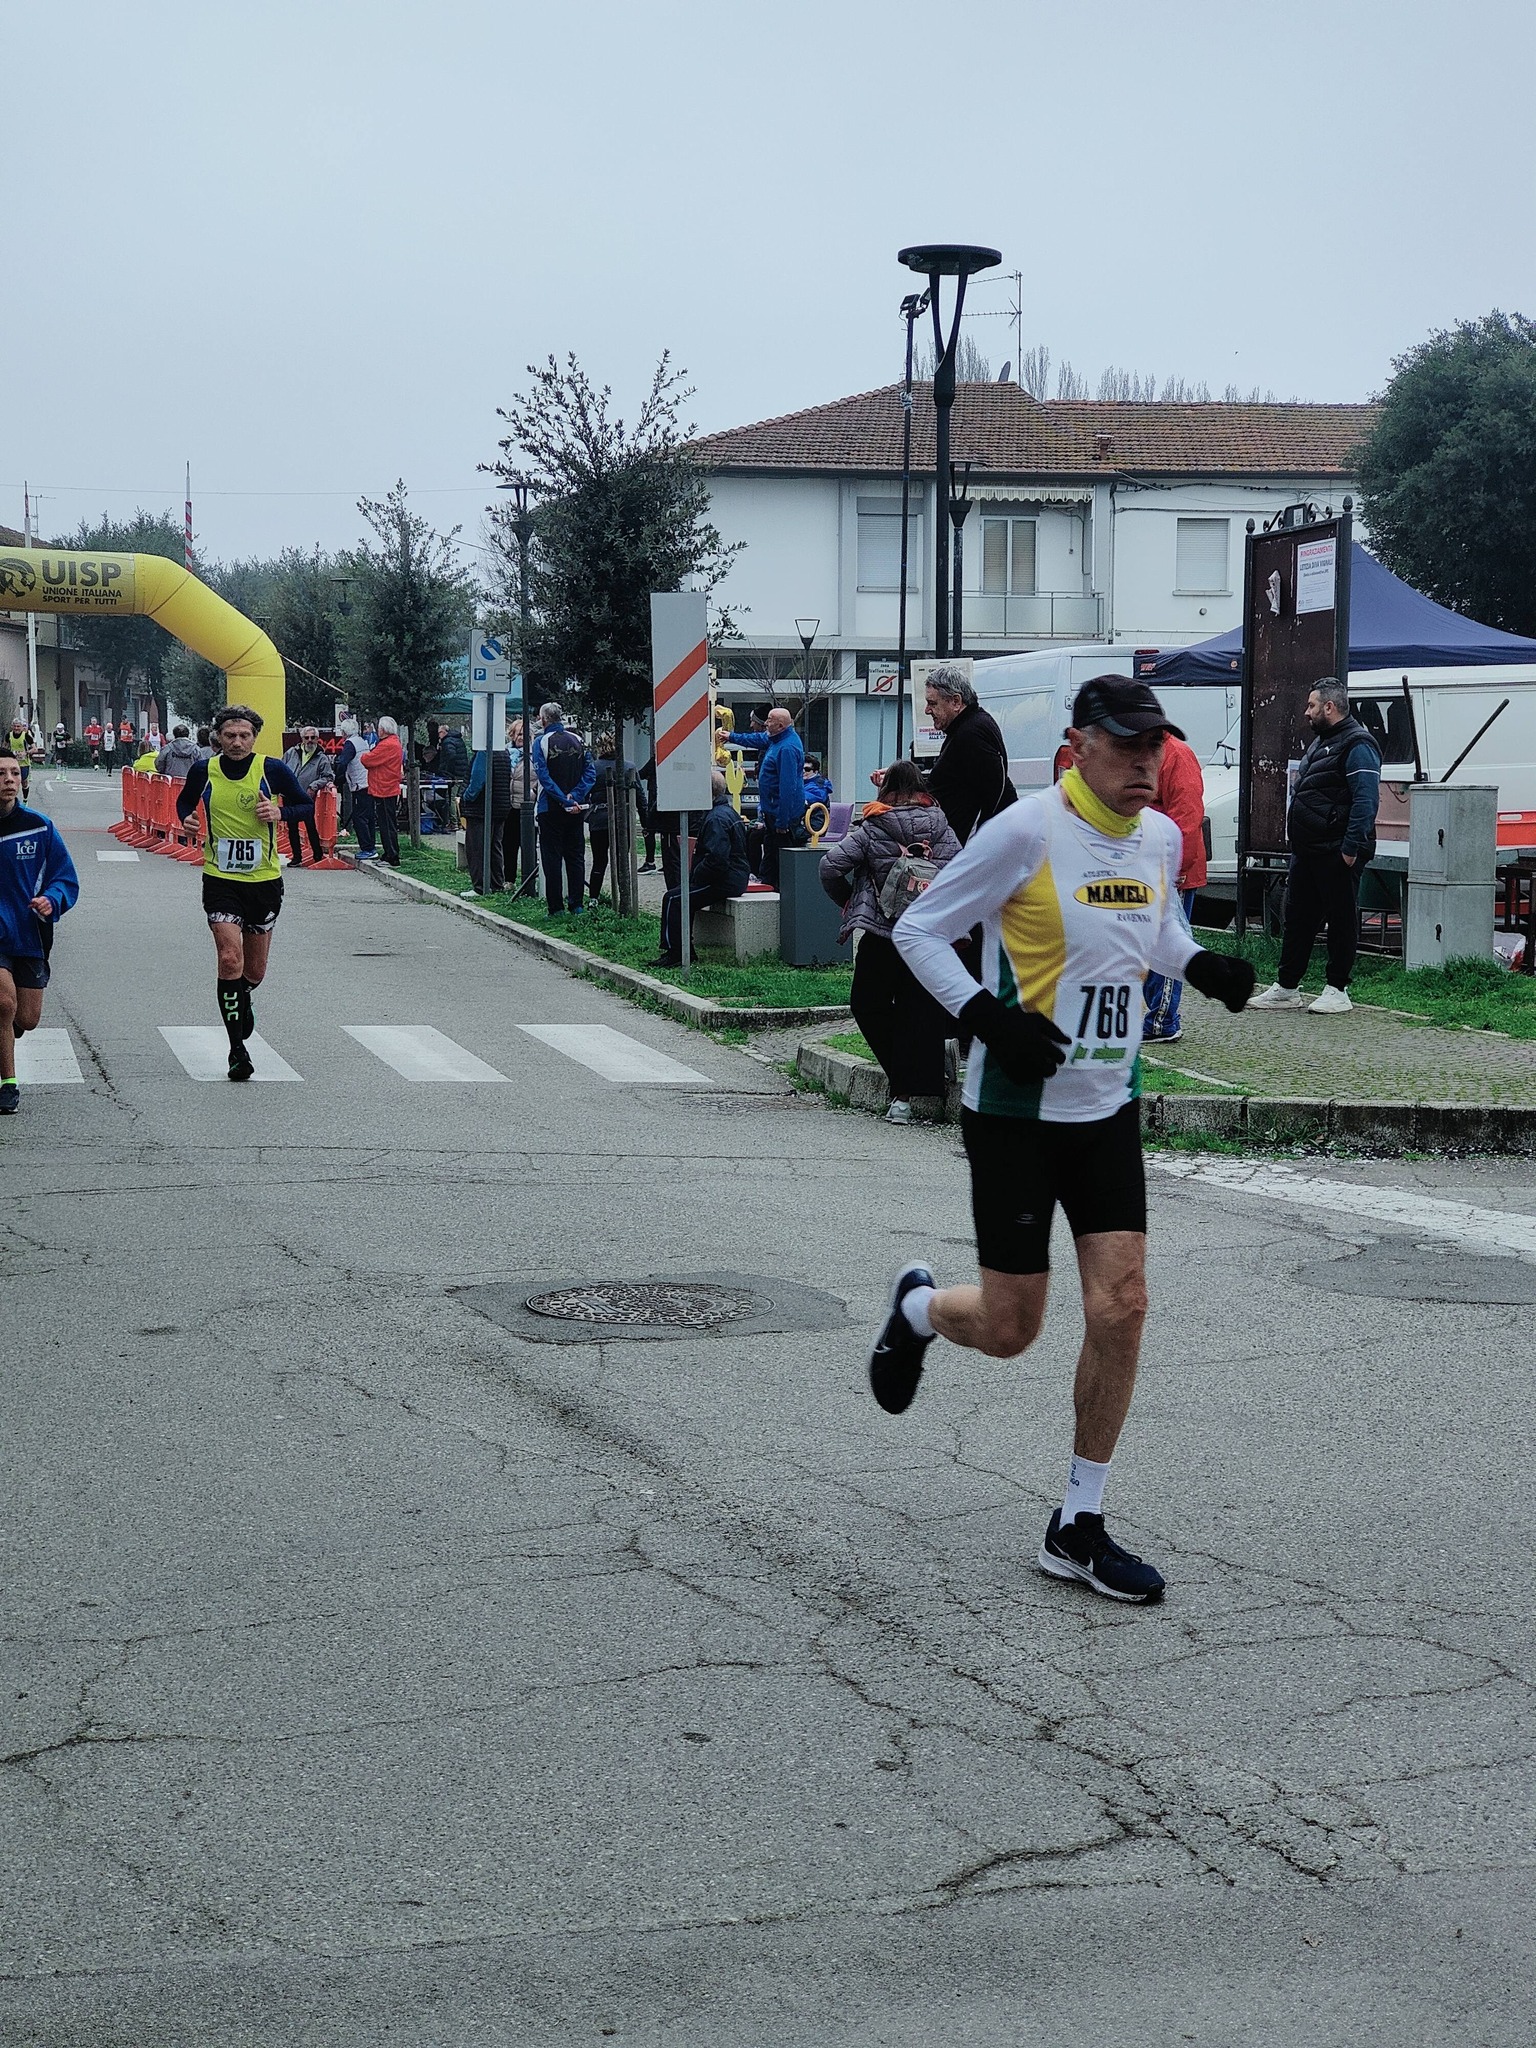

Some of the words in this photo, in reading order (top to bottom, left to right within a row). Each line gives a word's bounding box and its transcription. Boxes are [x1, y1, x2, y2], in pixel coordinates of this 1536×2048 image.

[42, 560, 121, 587] UISP
[42, 586, 78, 596] UNIONE
[81, 588, 122, 598] ITALIANA
[42, 595, 71, 604] SPORT
[74, 597, 91, 605] PER
[476, 669, 484, 680] P
[227, 840, 255, 861] 785
[1086, 885, 1150, 905] MAMELI
[1076, 985, 1130, 1039] 768
